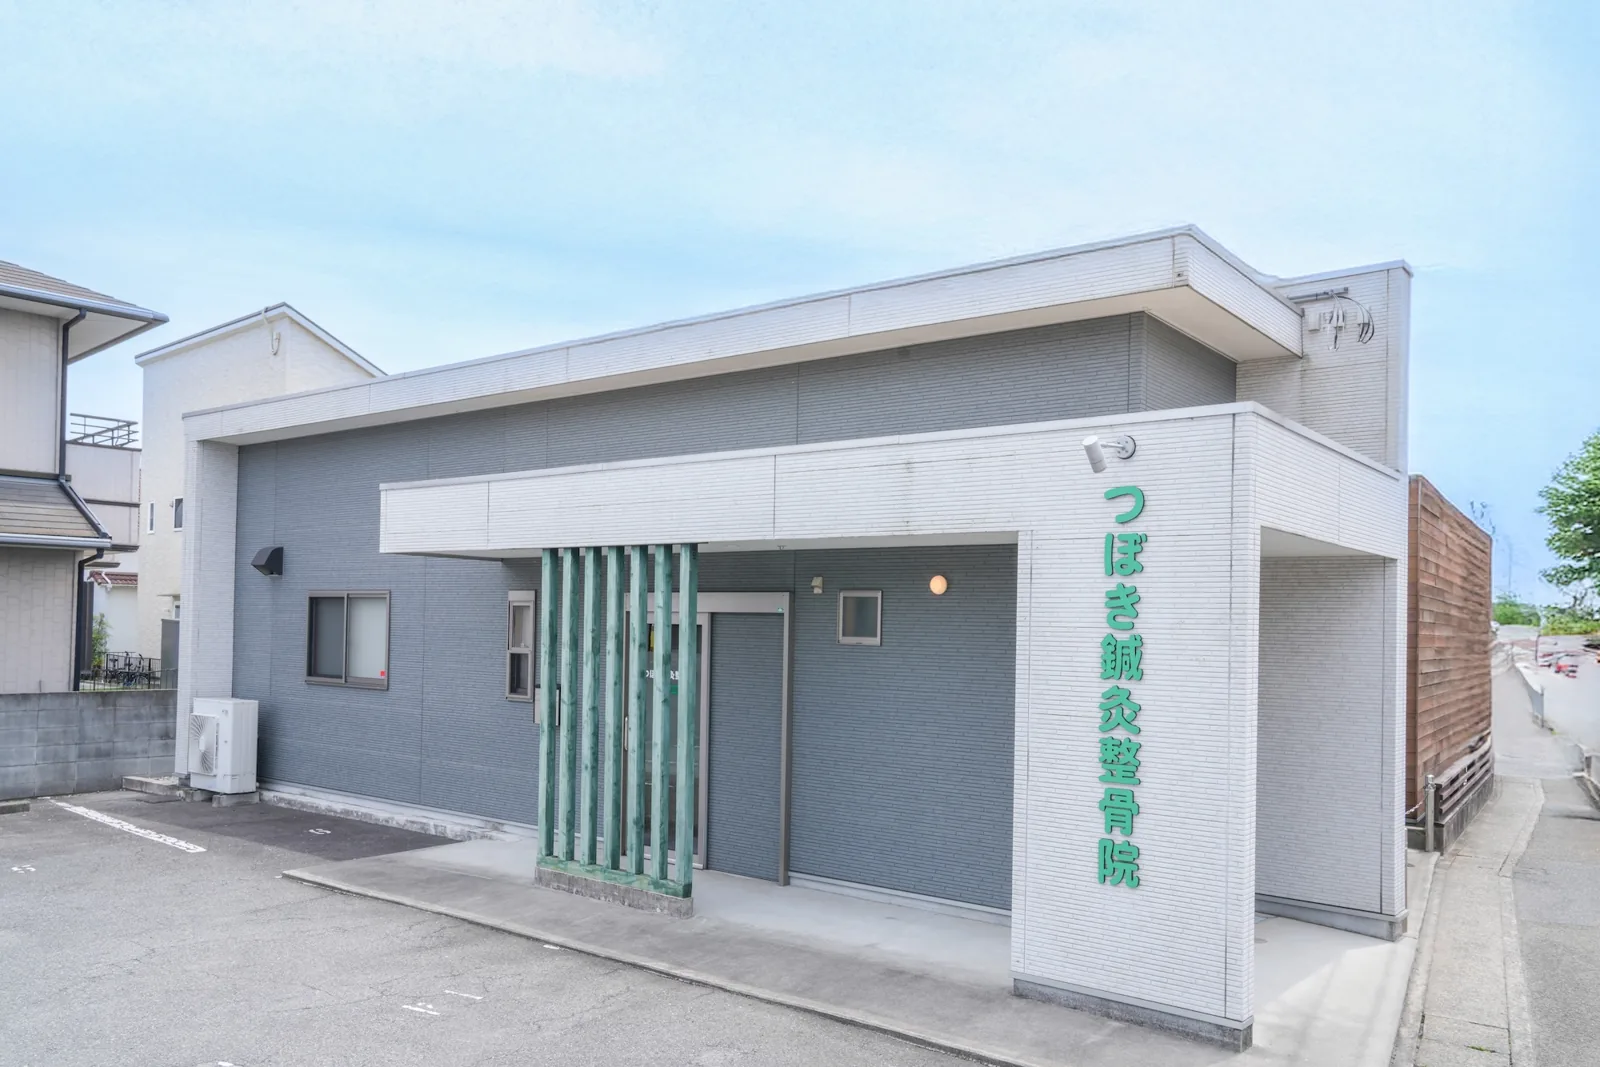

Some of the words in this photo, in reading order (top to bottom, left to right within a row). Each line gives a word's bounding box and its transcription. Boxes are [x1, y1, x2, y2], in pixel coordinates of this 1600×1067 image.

[1098, 485, 1147, 889] つぼき鍼灸整骨院
